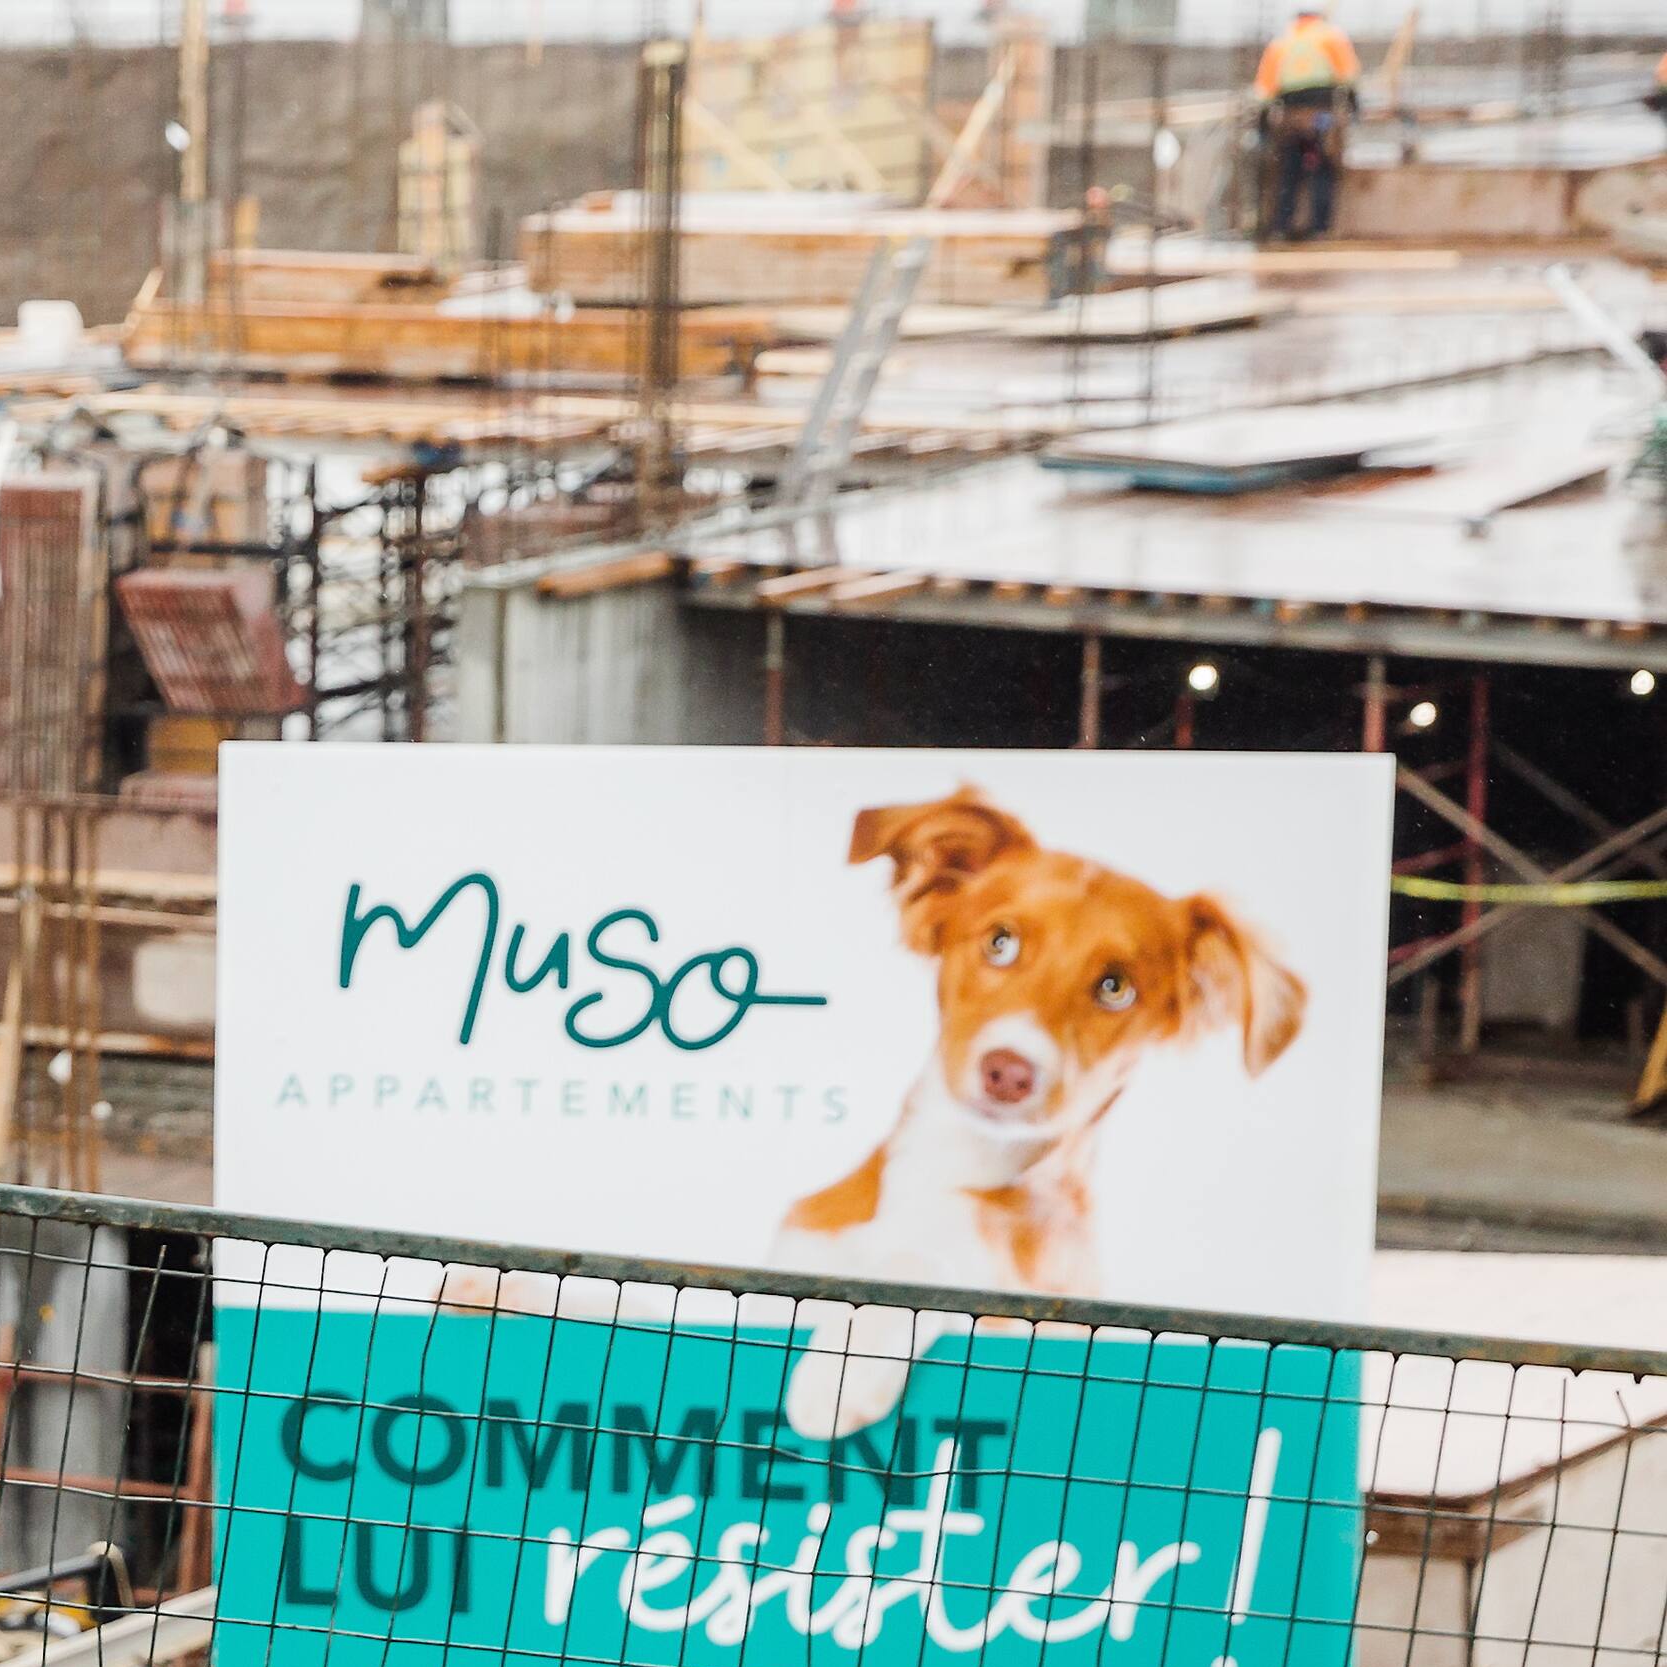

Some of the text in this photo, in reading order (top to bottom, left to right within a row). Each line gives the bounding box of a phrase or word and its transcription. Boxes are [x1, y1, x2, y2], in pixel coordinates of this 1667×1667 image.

[274, 1073, 851, 1124] APPARTEMENTS
[280, 1390, 1008, 1510] COMMENT
[284, 1516, 471, 1614] LUI
